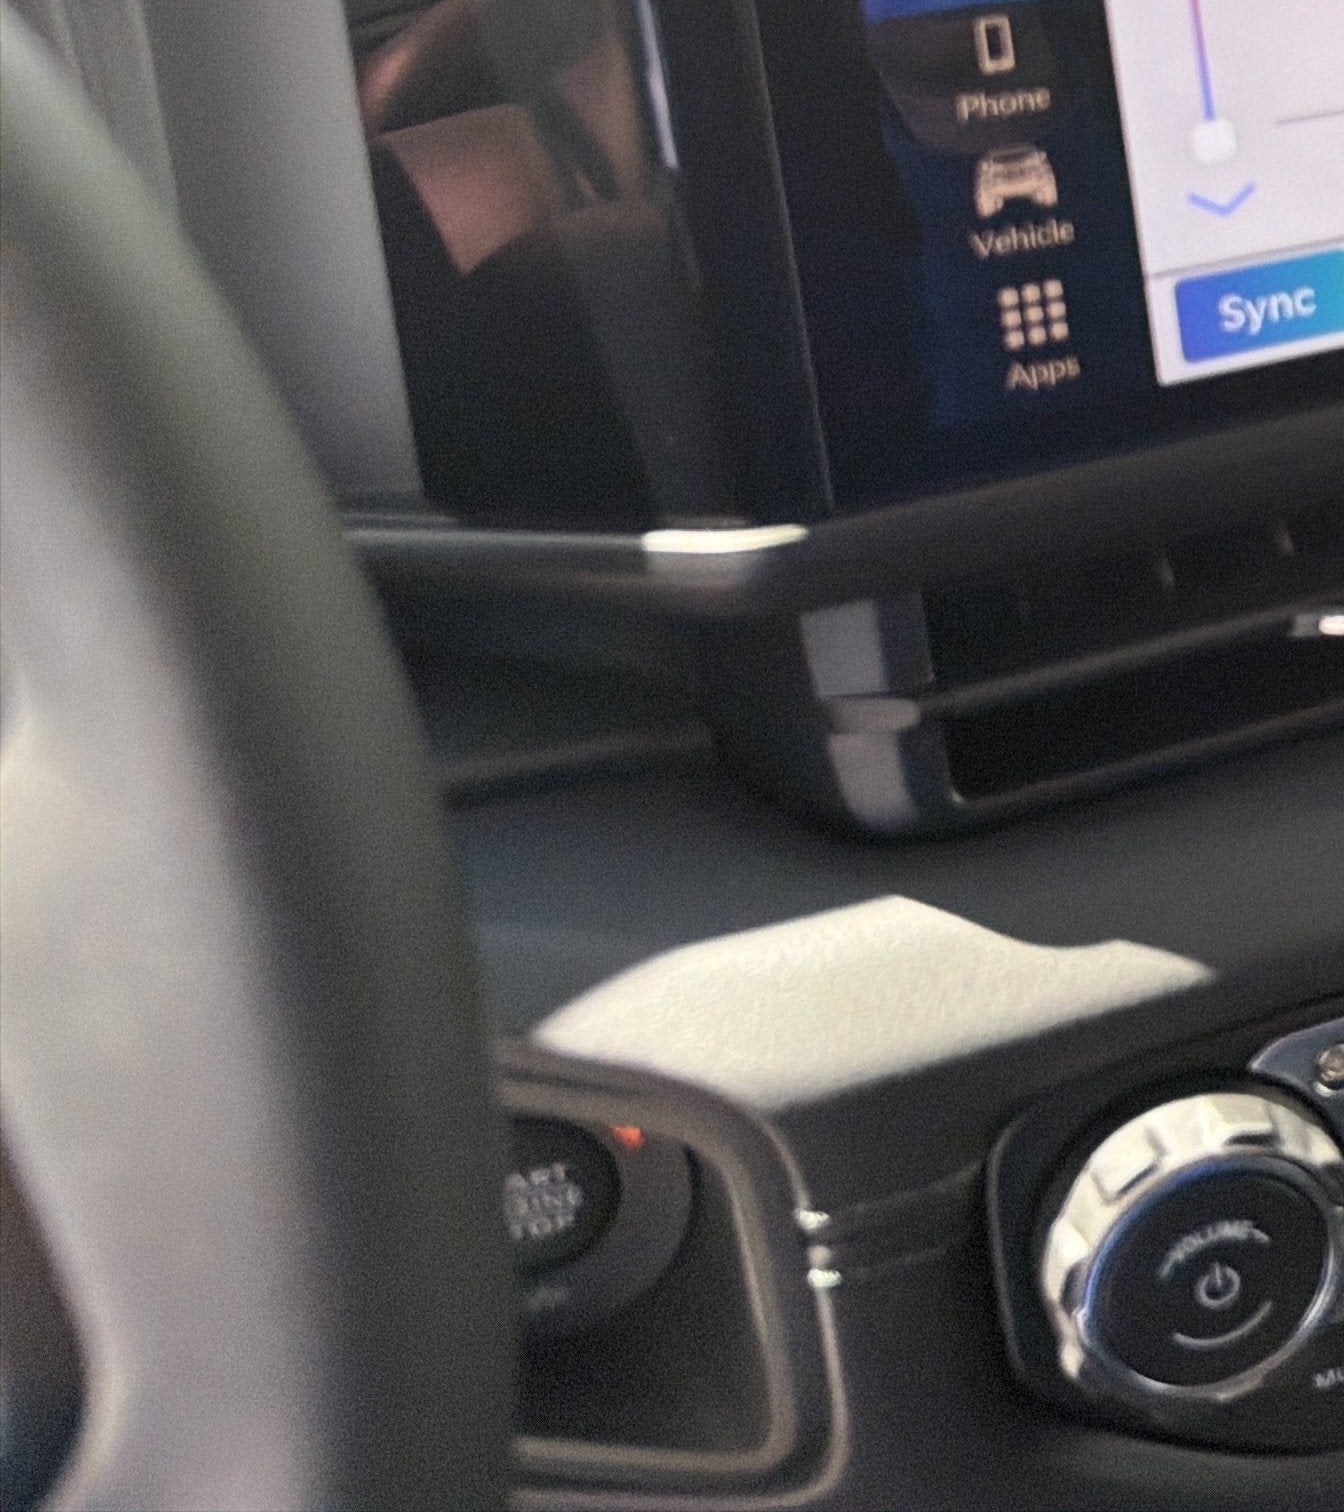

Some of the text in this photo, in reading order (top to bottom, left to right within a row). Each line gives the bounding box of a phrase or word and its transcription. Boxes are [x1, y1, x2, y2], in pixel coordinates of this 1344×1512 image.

[956, 86, 1052, 123] Phone
[968, 218, 1077, 260] Vehicle
[1217, 284, 1318, 335] Sync
[1006, 354, 1081, 392] Apps
[1168, 1219, 1255, 1268] VOLUME
